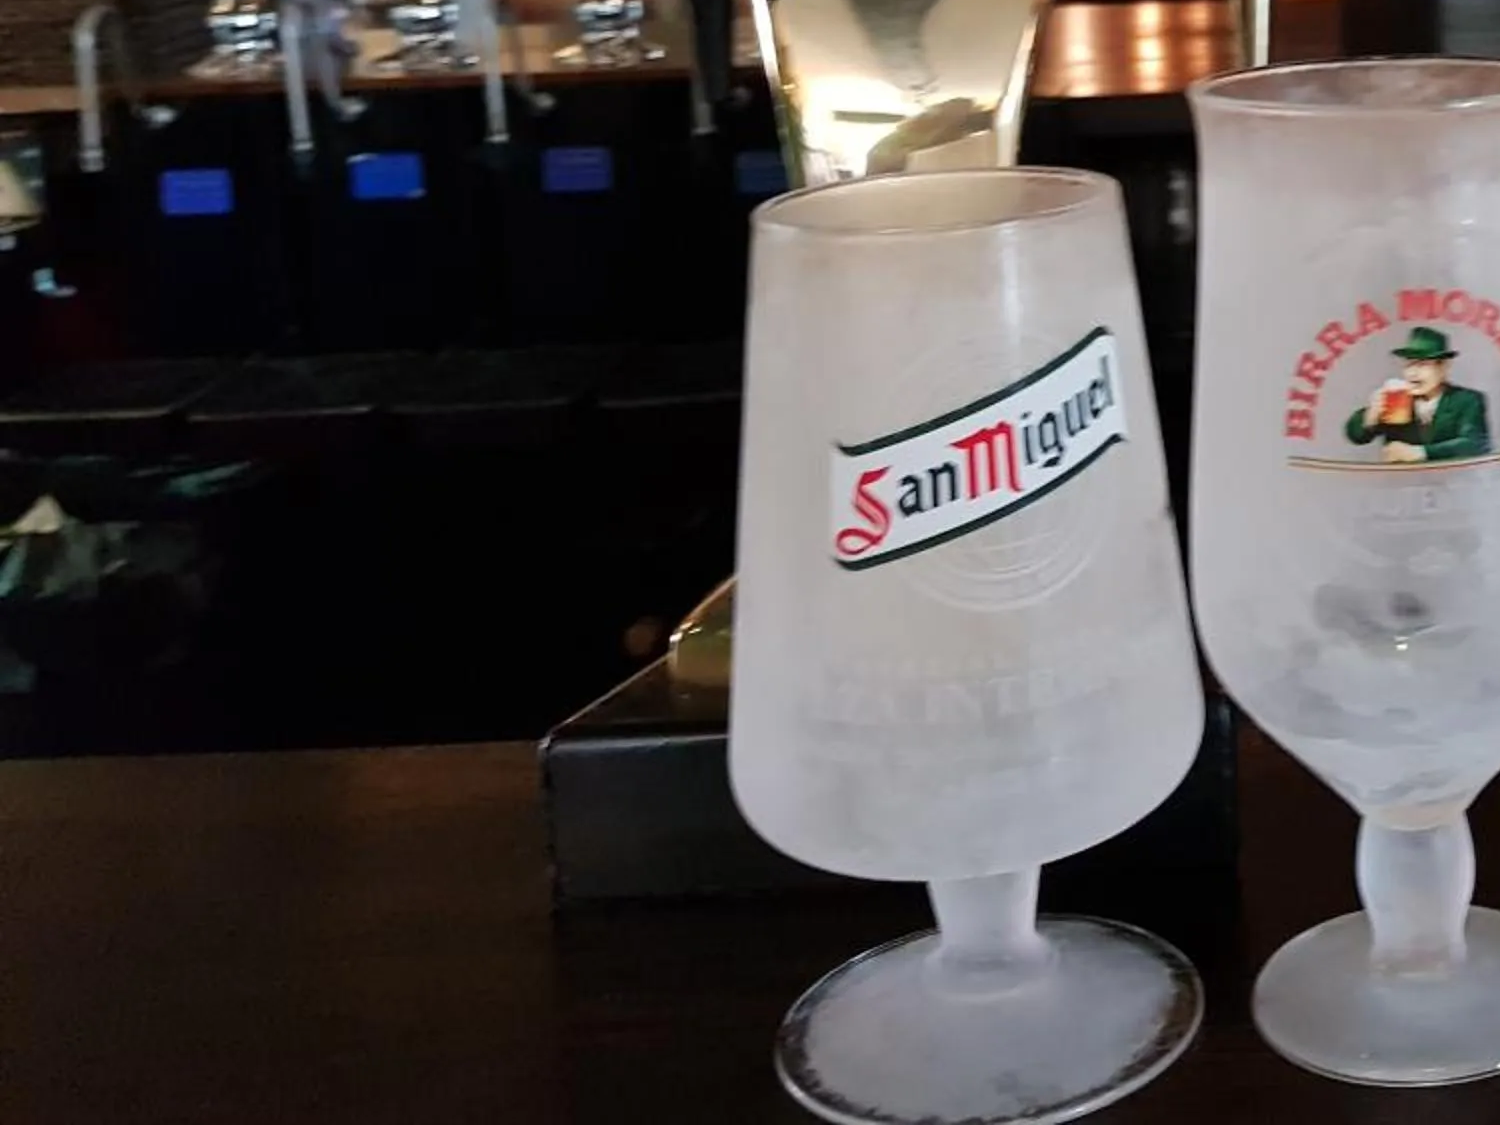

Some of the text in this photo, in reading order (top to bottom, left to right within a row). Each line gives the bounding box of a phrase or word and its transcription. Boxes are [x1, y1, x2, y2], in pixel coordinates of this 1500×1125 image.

[1284, 300, 1391, 439] BIRRA
[835, 354, 1115, 556] San Miguel
